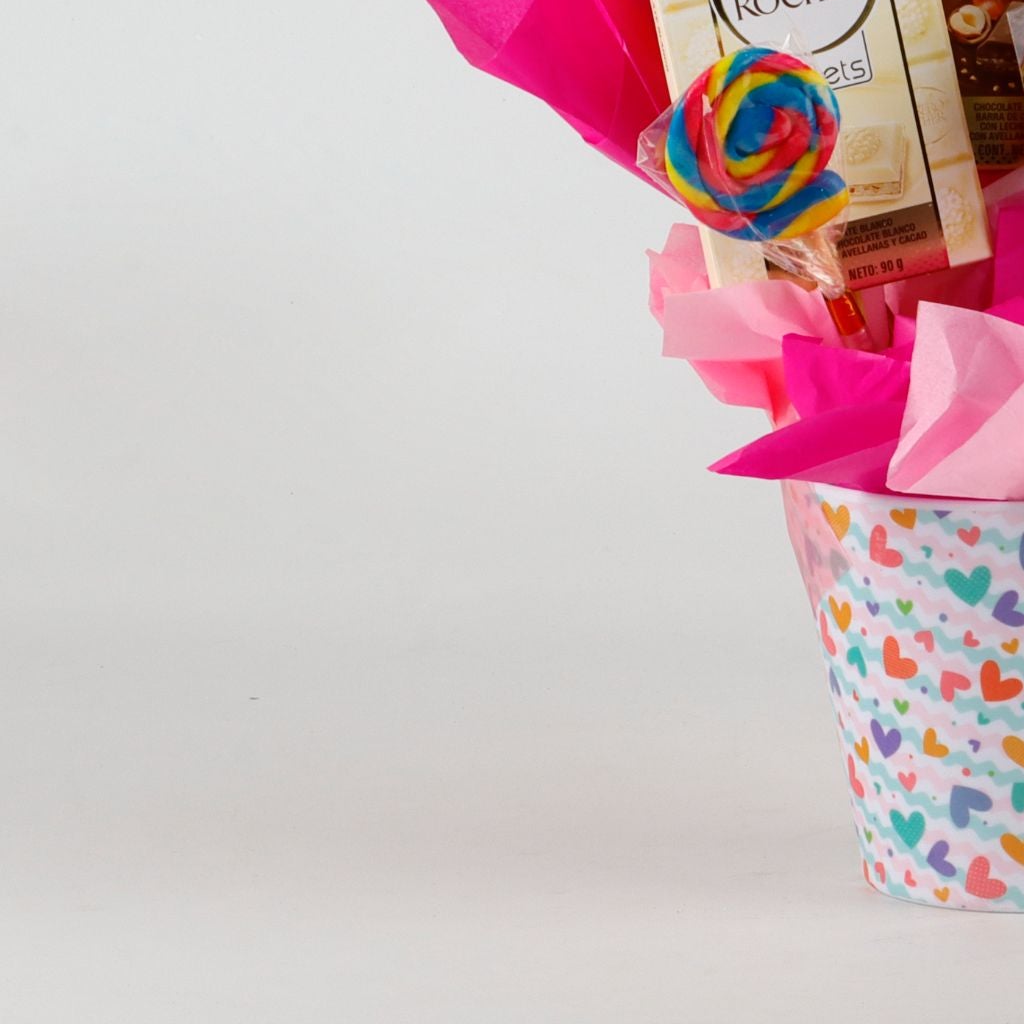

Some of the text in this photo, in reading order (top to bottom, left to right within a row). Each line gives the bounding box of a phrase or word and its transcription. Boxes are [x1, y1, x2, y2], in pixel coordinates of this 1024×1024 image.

[976, 112, 1005, 121] BARRA
[980, 122, 997, 131] CON
[860, 217, 893, 233] BLANCO
[837, 222, 916, 251] HOCOLATE BLANCO
[842, 230, 927, 258] AVELLANAS Y CACAO
[848, 258, 904, 280] NETO: 90 g
